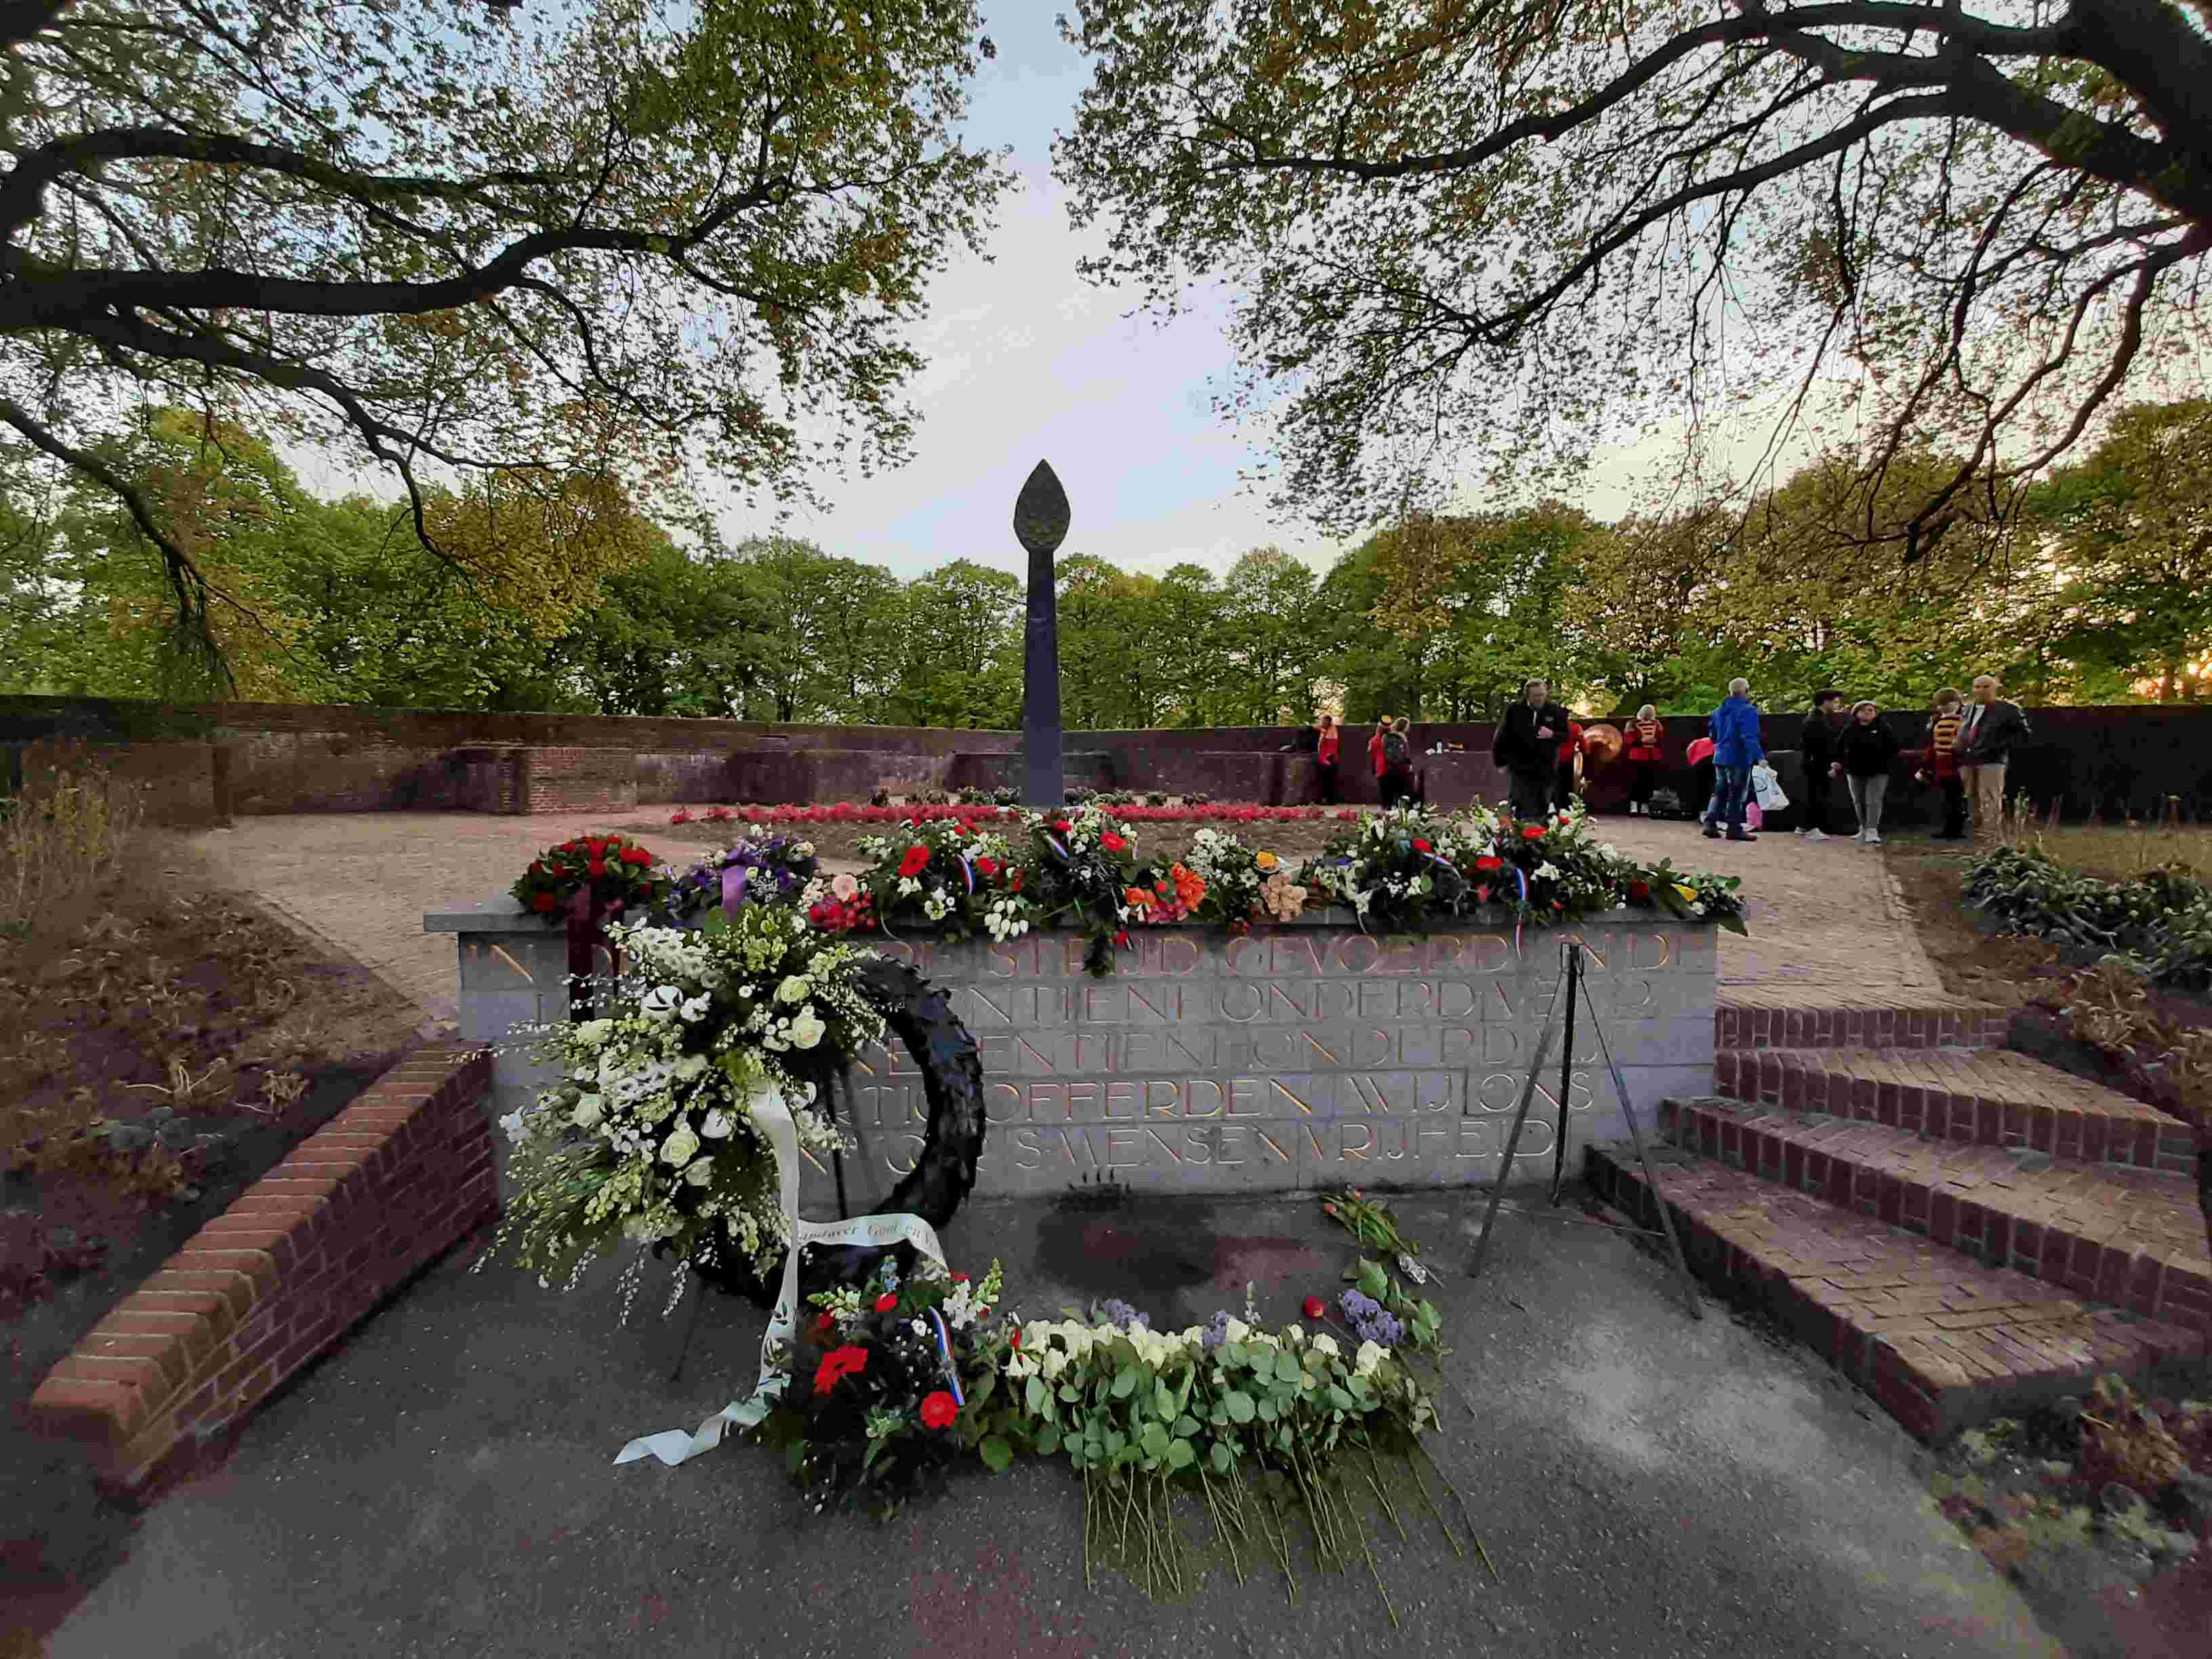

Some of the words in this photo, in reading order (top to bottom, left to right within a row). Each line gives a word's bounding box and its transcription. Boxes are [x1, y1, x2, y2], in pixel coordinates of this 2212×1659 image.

[983, 1076, 1315, 1124] OFFERDEN
[1347, 1072, 1454, 1116] WIJ
[1479, 1071, 1594, 1113] ONS
[1303, 1117, 1557, 1162] VRIJHEID
